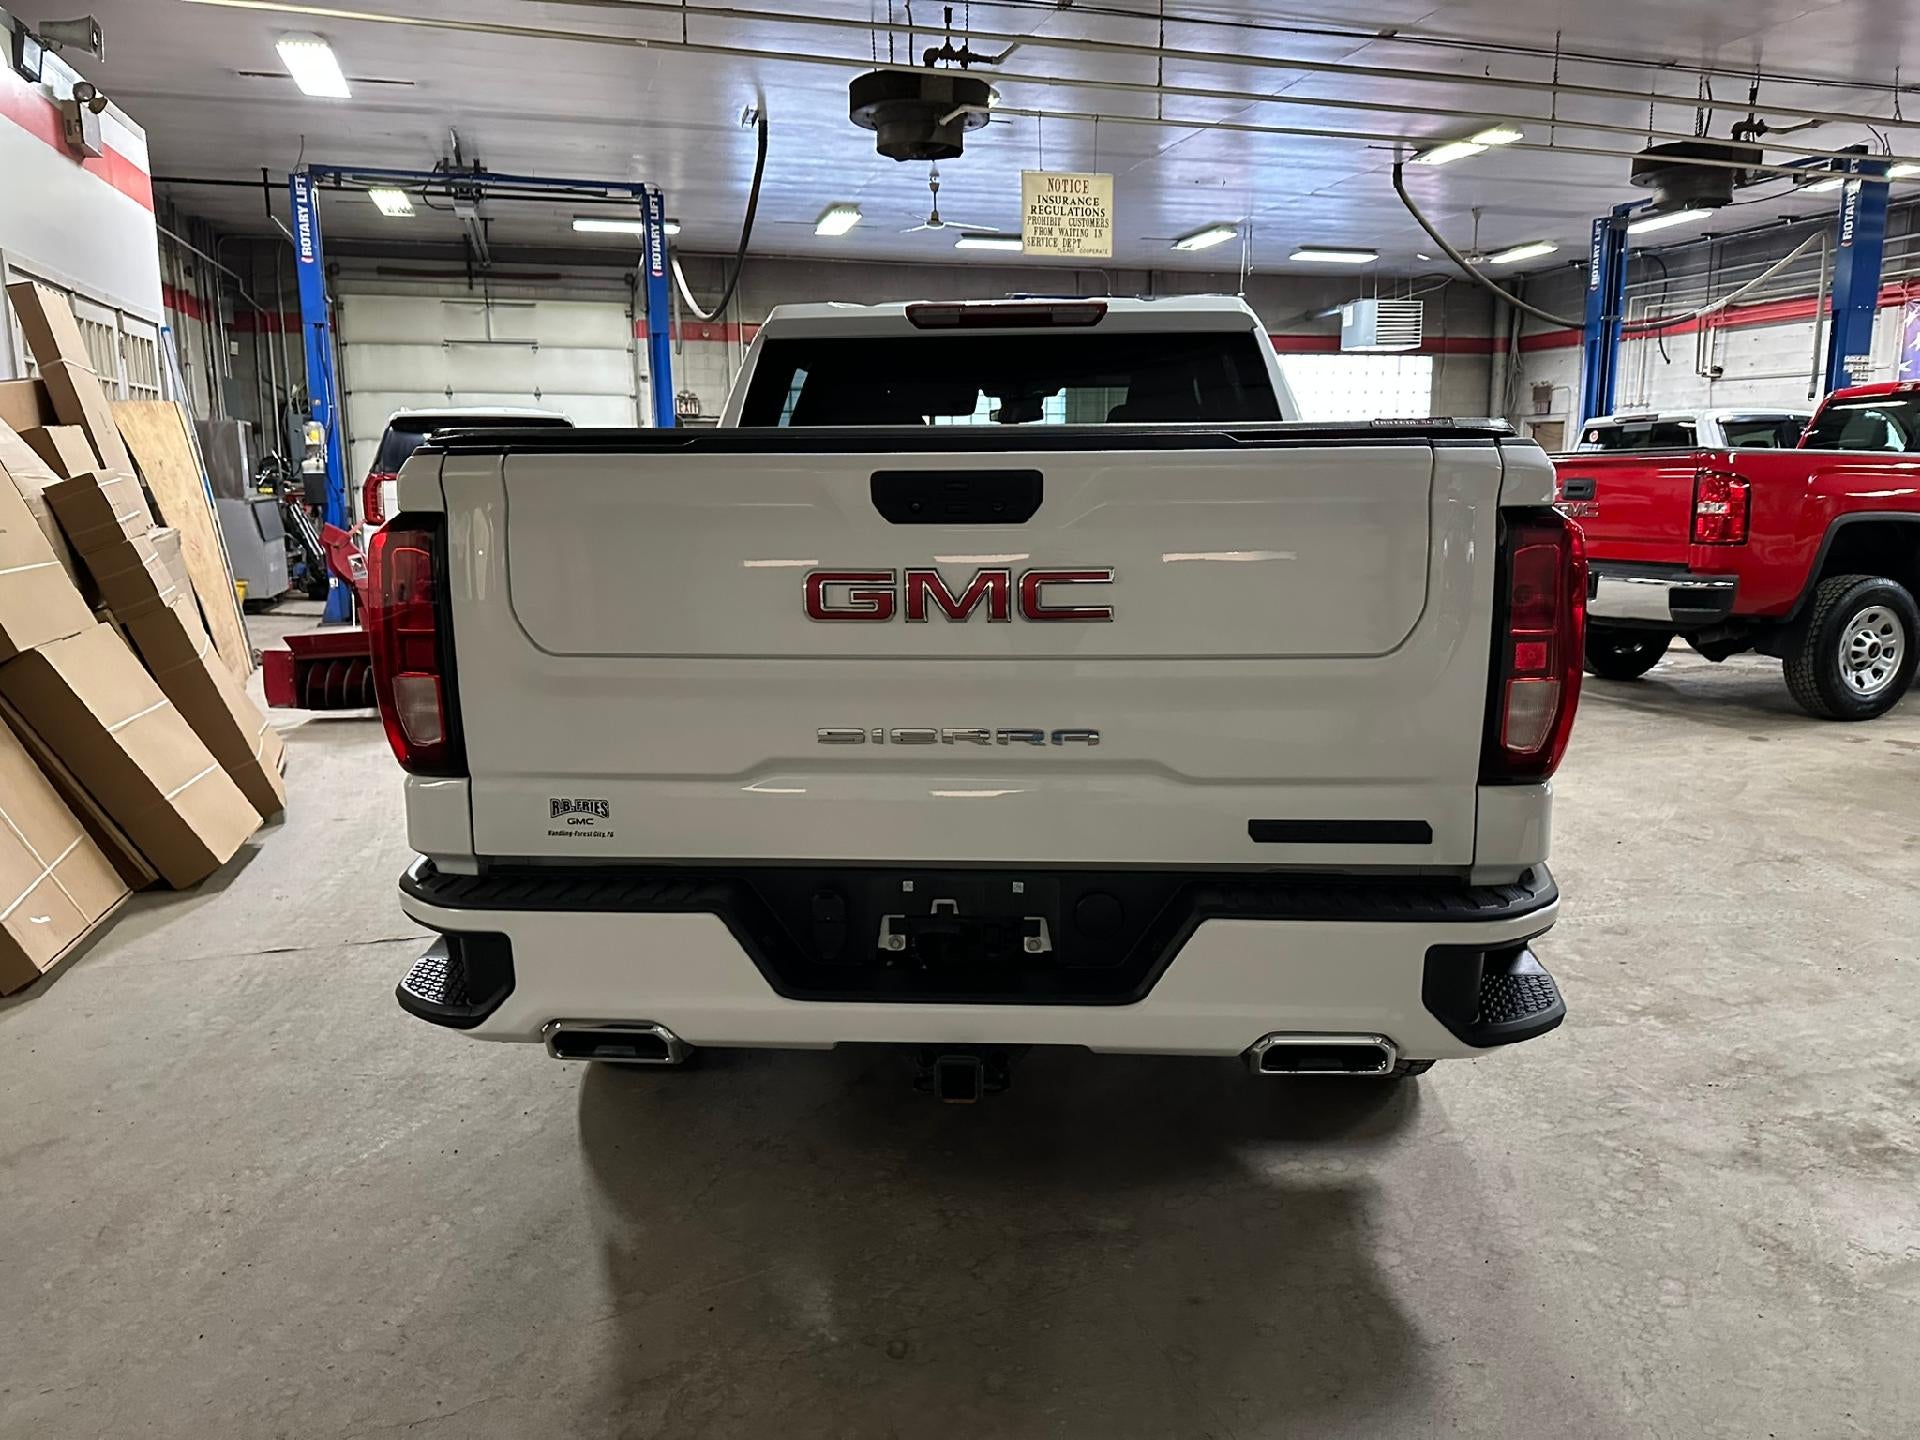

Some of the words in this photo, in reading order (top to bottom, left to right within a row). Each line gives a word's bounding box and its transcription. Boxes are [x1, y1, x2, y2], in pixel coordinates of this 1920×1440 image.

[295, 175, 308, 203] LIFT
[1047, 178, 1089, 194] NOTICE
[650, 193, 659, 220] LIFT
[1037, 194, 1100, 206] INSURANCE
[1030, 205, 1106, 218] REGULATIONS
[297, 205, 313, 256] ROTARY
[1027, 215, 1062, 227] PROHIBIT
[1068, 217, 1110, 228] CUSTOMERS
[1033, 226, 1054, 237] FROM
[1058, 227, 1089, 238] WAITING
[1094, 228, 1103, 238] IN
[651, 222, 662, 270] ROTARY
[1026, 236, 1059, 248] SERVICE
[1591, 244, 1600, 285] ROTARY
[678, 401, 698, 414] EXIT
[803, 566, 1115, 623] GMC
[817, 727, 1100, 746] SIERRA
[575, 799, 610, 818] FRIES
